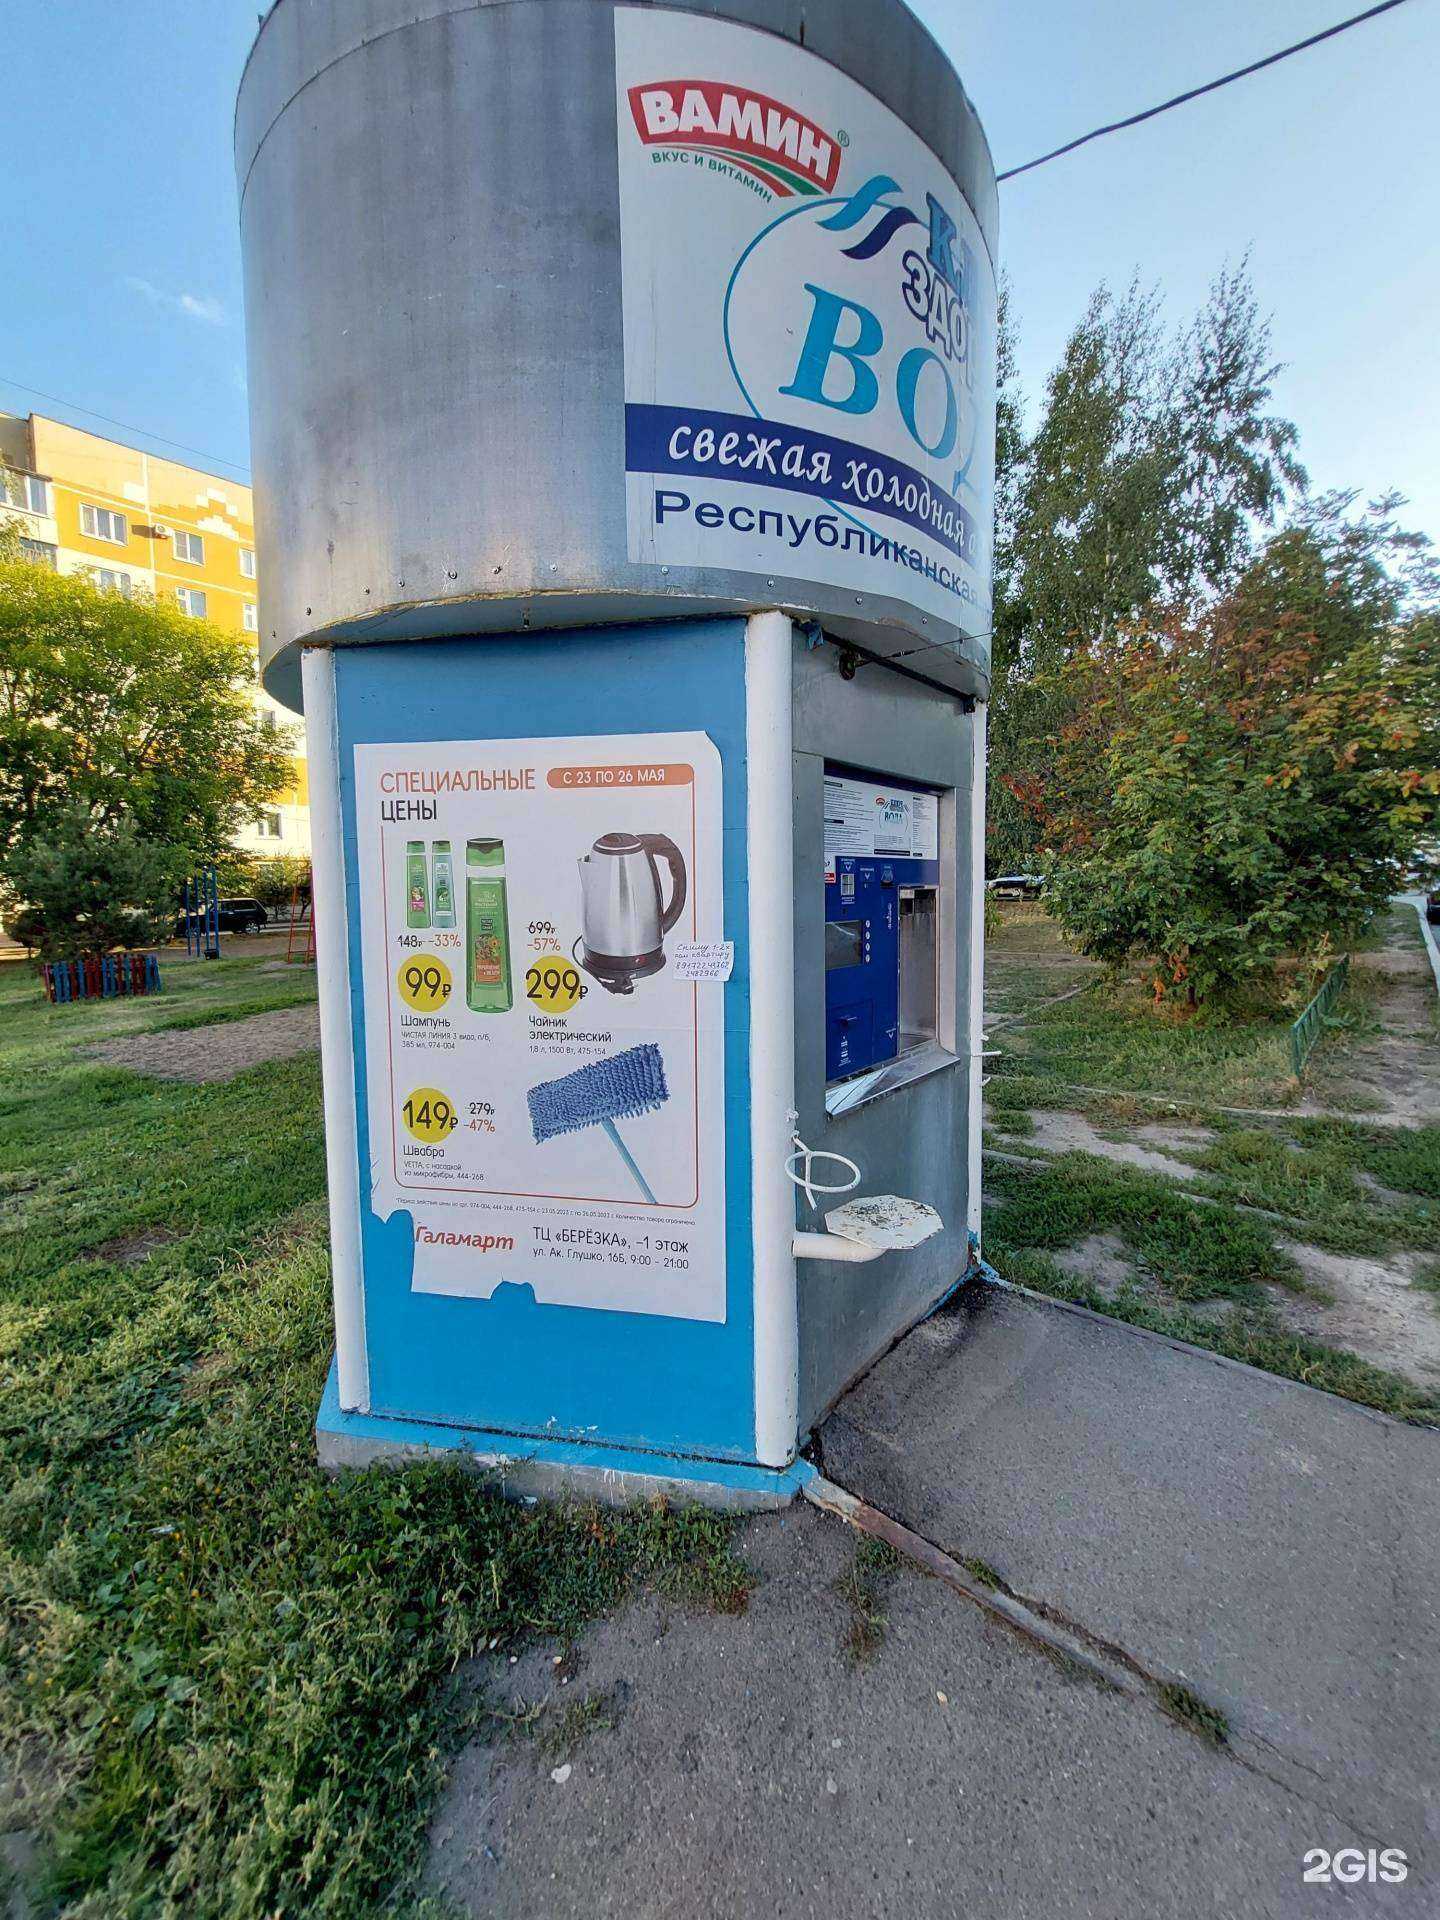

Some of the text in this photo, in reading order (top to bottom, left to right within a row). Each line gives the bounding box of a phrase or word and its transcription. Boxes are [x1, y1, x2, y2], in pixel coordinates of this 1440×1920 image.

[641, 89, 832, 182] ВАМИН
[652, 151, 773, 204] ВКУС И ВИТАМИН
[902, 250, 974, 385] ЗДО
[778, 283, 957, 460] ВО
[668, 425, 965, 546] свежая холодная
[380, 768, 536, 794] СПЕЦИАЛЬНЫЕ
[563, 768, 665, 784] С 23 ПО 26 МАЯ
[381, 799, 437, 823] ЦЕНЫ
[400, 1014, 451, 1030] Шампунь
[528, 1015, 568, 1028] Чайник
[401, 1031, 427, 1040] ЧИСТАЯ
[428, 1031, 451, 1040] ЛИНИЯ
[529, 1031, 612, 1044] электрический
[549, 1046, 565, 1054] 1500
[577, 1047, 606, 1055] 475-154
[403, 1145, 445, 1159] Швабра
[431, 1163, 462, 1171] насадкой
[456, 1172, 485, 1181] 444-268
[416, 1226, 514, 1253] Галамарт
[533, 1227, 551, 1242] ТЦ
[555, 1228, 631, 1249] «БЕРЁЗКА»,
[655, 1240, 689, 1253] этаж
[533, 1248, 546, 1258] ул.
[549, 1248, 564, 1258] Ак.
[567, 1249, 605, 1262] Глушко,
[630, 1254, 651, 1265] 9:00
[663, 1257, 689, 1270] 21:00
